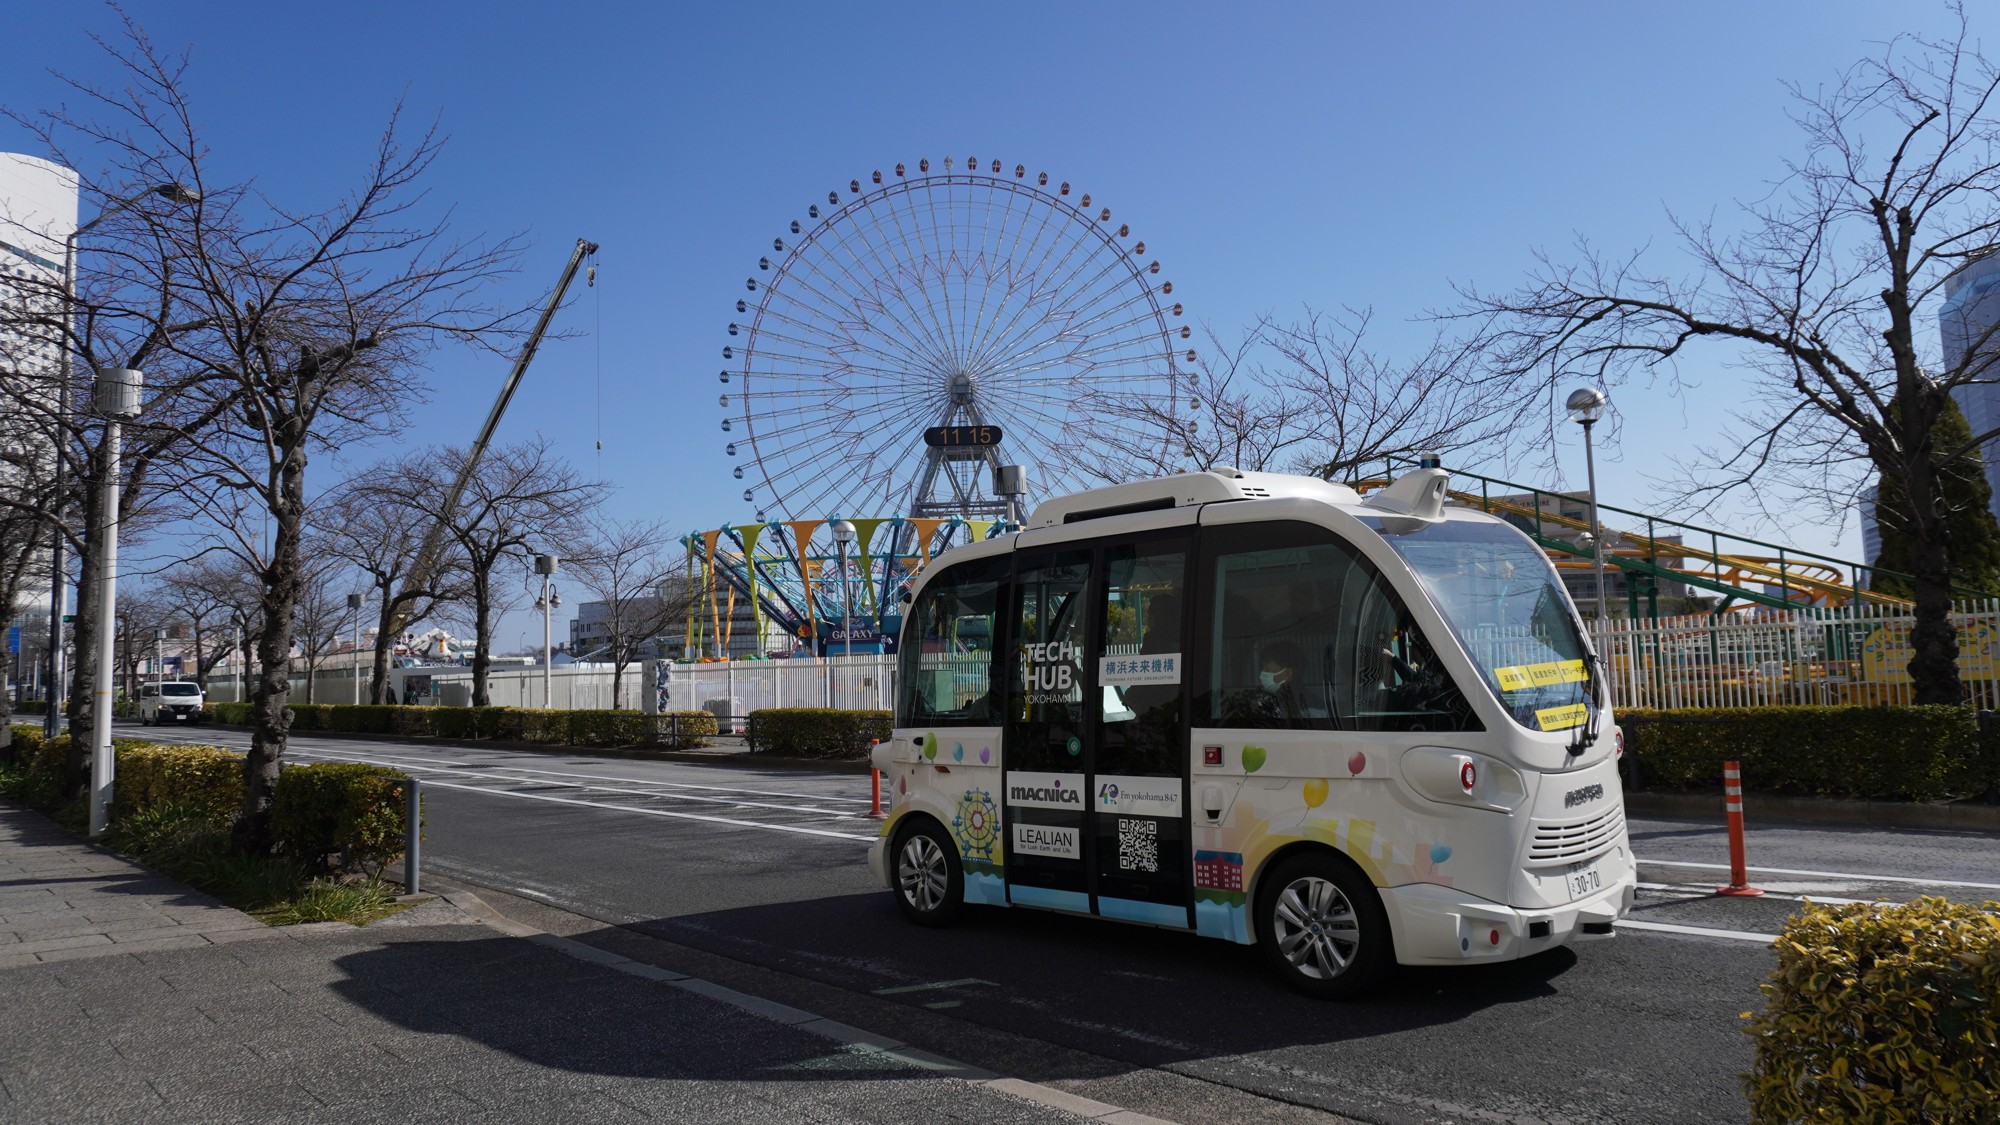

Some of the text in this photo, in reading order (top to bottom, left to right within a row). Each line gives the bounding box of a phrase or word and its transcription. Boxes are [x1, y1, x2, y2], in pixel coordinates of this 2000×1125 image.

[940, 427, 991, 445] 11 15
[1025, 641, 1073, 662] TECH
[1105, 658, 1174, 675] 横浜未来機構
[1024, 665, 1072, 690] HUB
[1131, 792, 1164, 802] yokohama
[1020, 829, 1072, 847] LEALIAN
[1575, 870, 1600, 894] 30-70
